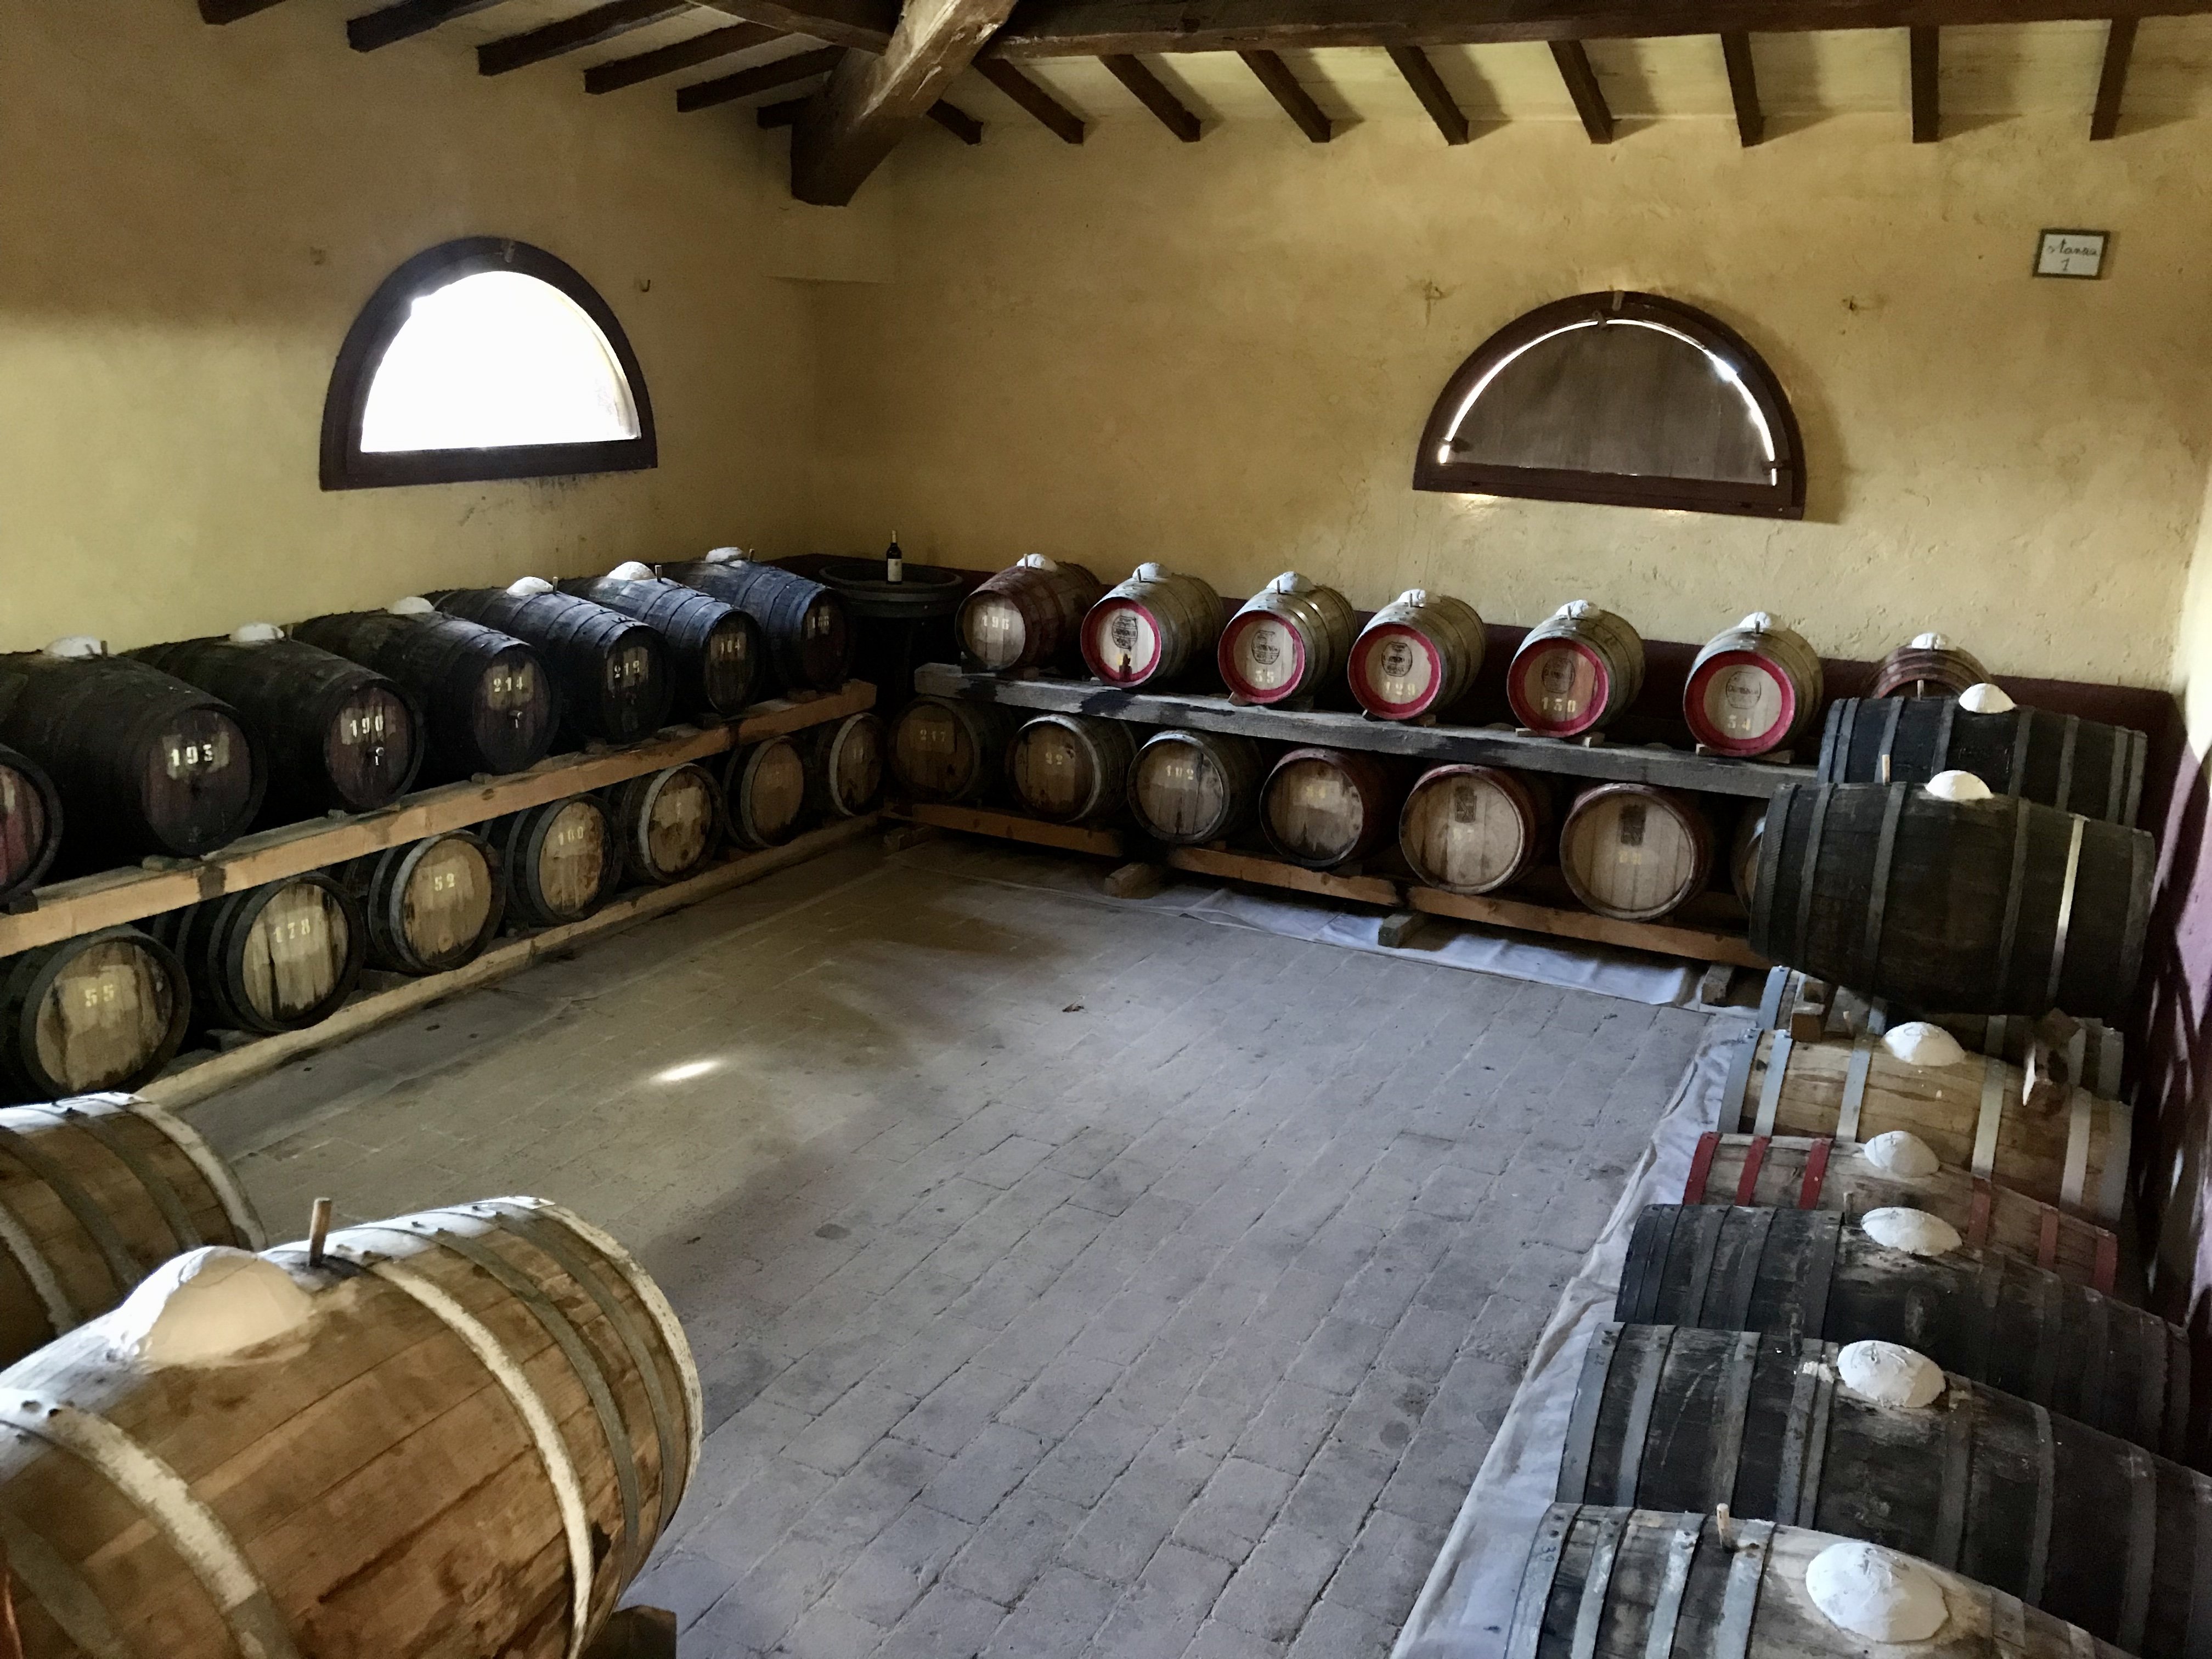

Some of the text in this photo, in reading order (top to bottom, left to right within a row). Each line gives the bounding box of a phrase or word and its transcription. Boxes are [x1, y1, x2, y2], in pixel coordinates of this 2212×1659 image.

[2060, 257, 2071, 272] 1
[981, 615, 1010, 630] 196
[493, 676, 523, 692] 214
[1255, 670, 1274, 684] 55
[350, 715, 384, 738] 190
[171, 744, 213, 767] 193
[435, 873, 455, 891] 52
[84, 984, 115, 1007] 55
